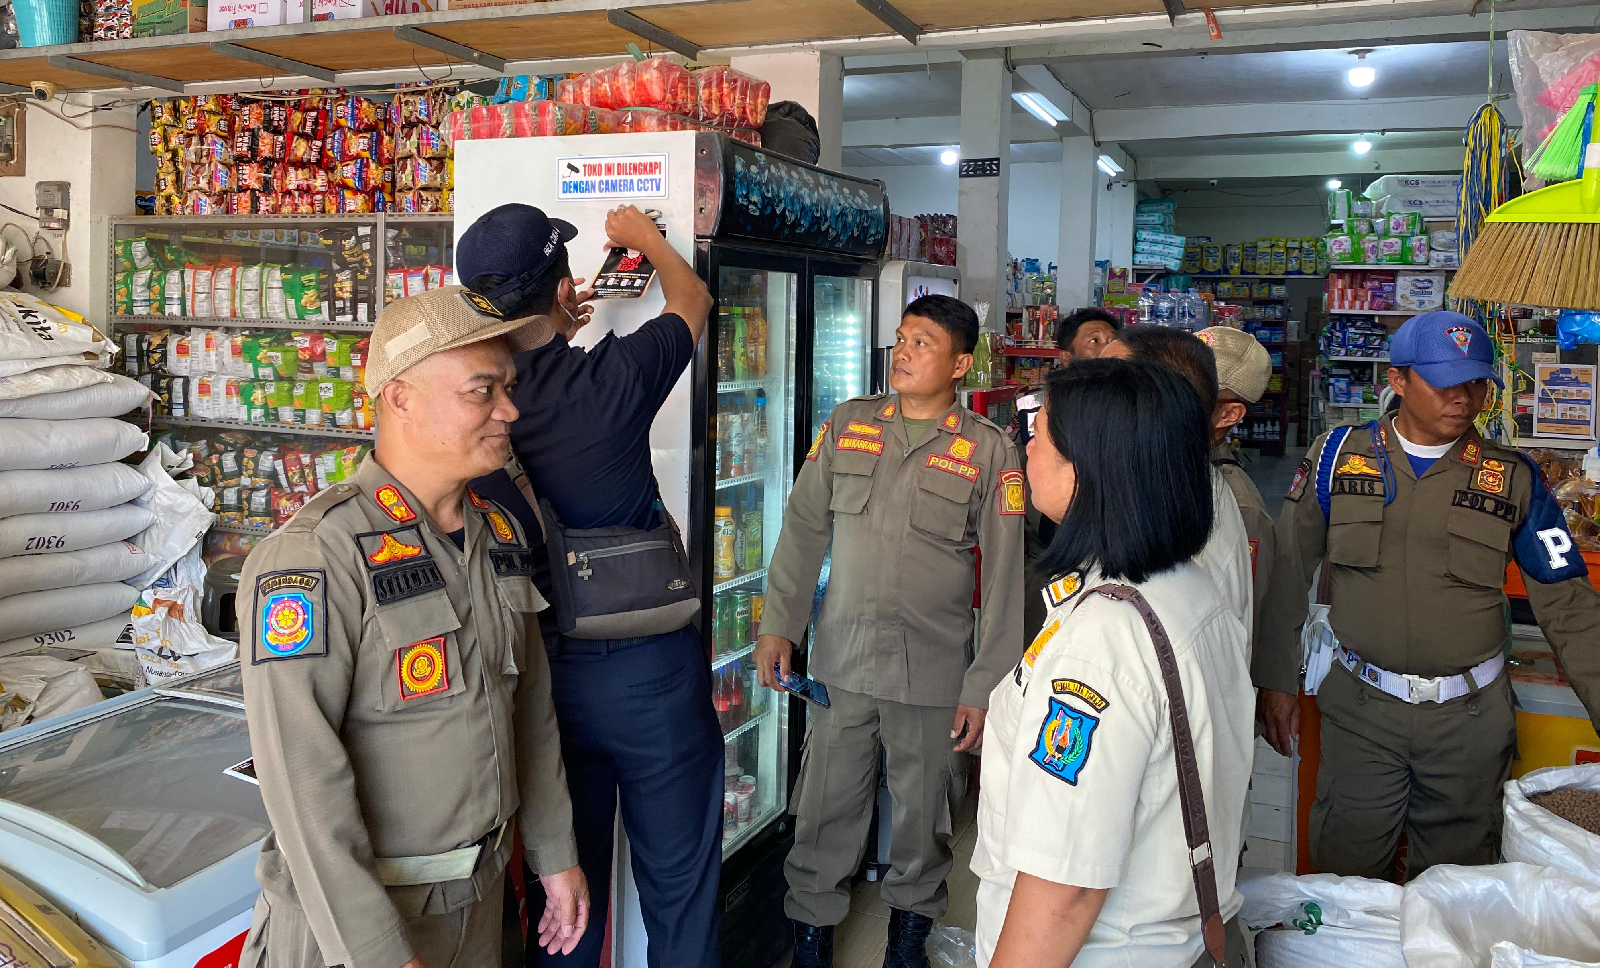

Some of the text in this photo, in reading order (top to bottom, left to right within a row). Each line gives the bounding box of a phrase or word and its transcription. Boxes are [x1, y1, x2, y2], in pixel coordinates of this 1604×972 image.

[583, 161, 662, 177] TOKO INI DILENGKAPI
[562, 178, 662, 194] DENGAN CAMERA CCTV
[930, 457, 976, 477] POL PP
[1338, 480, 1375, 494] ARIS
[48, 500, 81, 512] 9301
[1458, 490, 1516, 523] POL PP
[25, 535, 66, 551] 9302
[1536, 527, 1572, 570] P
[33, 629, 76, 647] 9302
